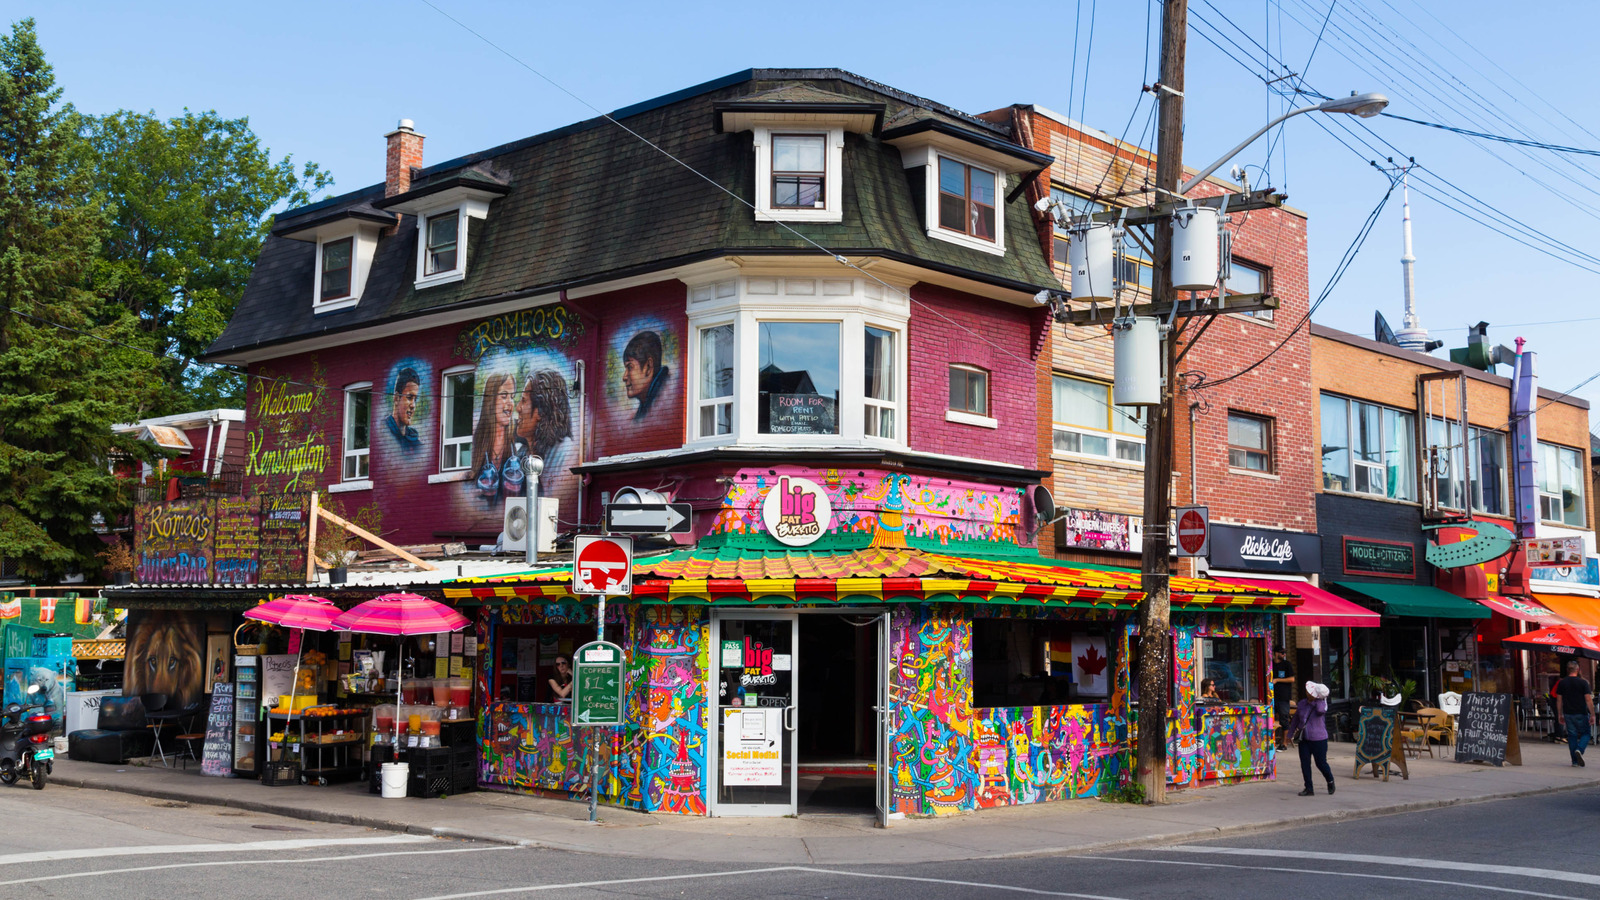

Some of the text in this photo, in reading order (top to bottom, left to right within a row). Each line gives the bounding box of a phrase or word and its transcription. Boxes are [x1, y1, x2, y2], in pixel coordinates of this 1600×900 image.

[470, 306, 567, 357] ROMEO'S
[256, 379, 313, 418] Welcome
[779, 396, 824, 407] ROOM FOR
[792, 406, 814, 414] RENT
[246, 429, 326, 491] Kensington
[781, 477, 816, 524] big
[147, 505, 210, 541] Romeo's
[781, 514, 802, 525] FAT
[1240, 535, 1293, 564] Rick's Cafe
[1352, 546, 1407, 562] MODEL CITIZEN
[137, 551, 208, 583] JUICE BAR
[745, 636, 773, 676] big
[744, 667, 761, 675] FAT
[760, 698, 788, 707] OPEN
[1466, 693, 1506, 707] Thirsty?
[1457, 729, 1463, 738] A
[1464, 728, 1482, 738] FRUIT
[726, 750, 751, 760] Social
[1456, 742, 1504, 760] LEMONADE
